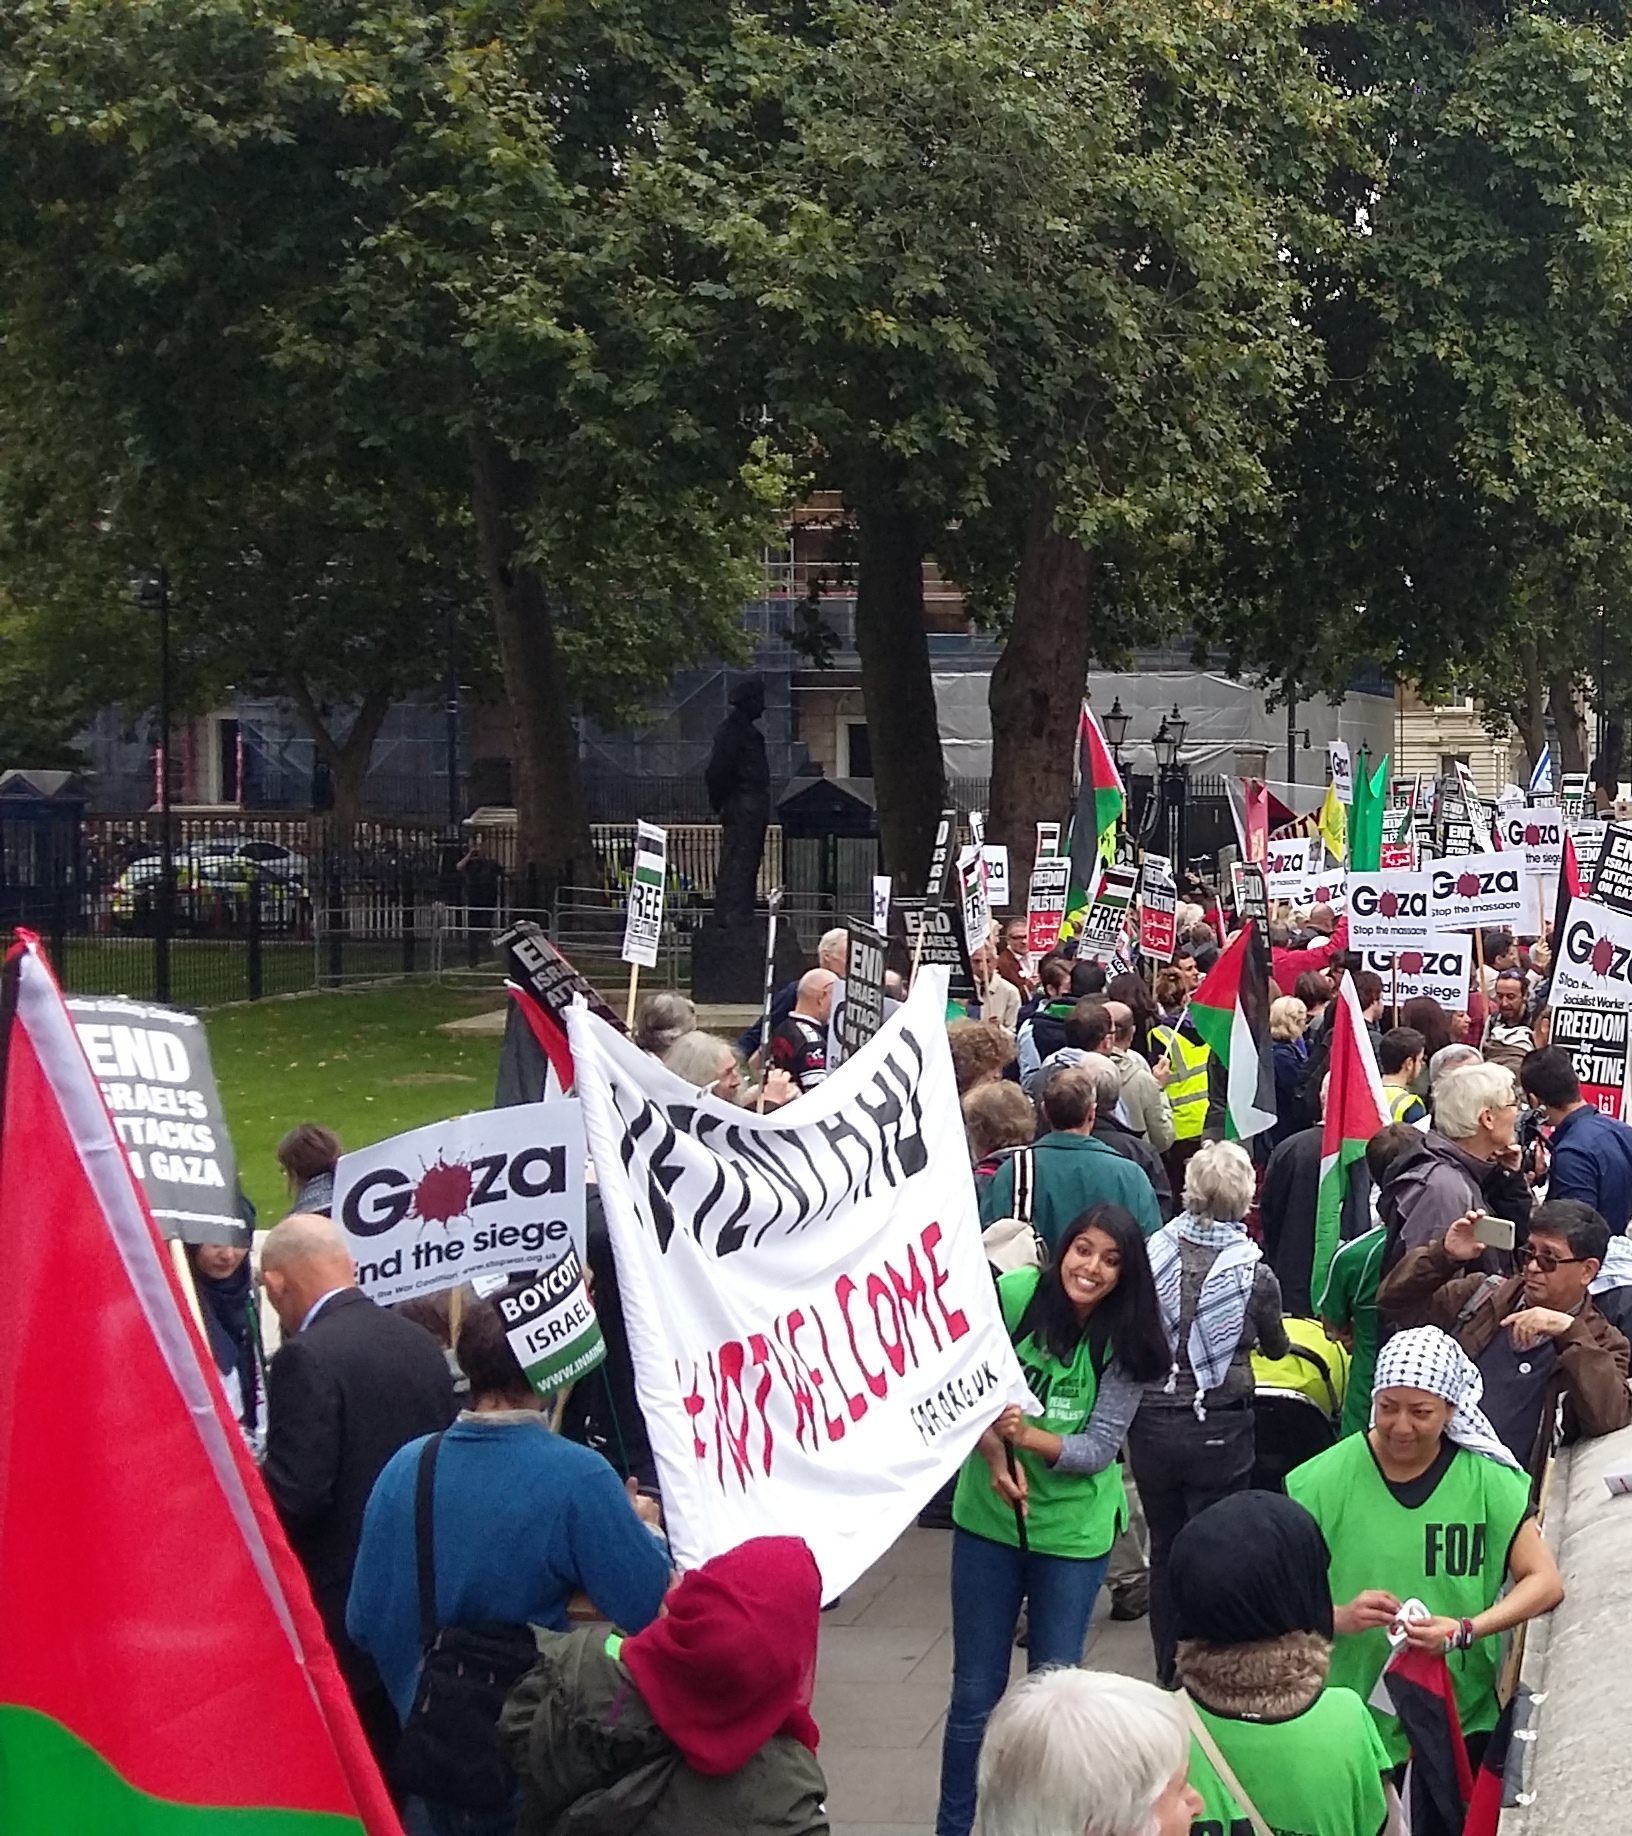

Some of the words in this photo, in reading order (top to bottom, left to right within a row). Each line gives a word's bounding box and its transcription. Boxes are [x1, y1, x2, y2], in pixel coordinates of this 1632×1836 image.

[1332, 751, 1350, 778] Gza
[1393, 795, 1424, 808] FRE
[1443, 800, 1465, 815] END
[1508, 819, 1560, 846] Gza
[1267, 851, 1303, 874] Gza
[1526, 852, 1541, 864] the
[1294, 882, 1348, 906] Gza
[1432, 870, 1519, 900] Gza
[1597, 882, 1614, 895] ON
[1352, 885, 1428, 920] Gza
[1454, 903, 1470, 914] the
[1471, 900, 1521, 913] massacre
[1085, 904, 1127, 932] FREE
[1353, 925, 1374, 937] Stop
[1376, 925, 1389, 935] the
[1390, 926, 1428, 936] massacre
[1367, 950, 1463, 977] Gza
[1396, 982, 1418, 995] the
[1422, 983, 1461, 1001] siege
[1563, 993, 1596, 1007] Socialist
[1596, 994, 1625, 1010] Worker
[1554, 1008, 1627, 1043] FREEDOM
[74, 1023, 191, 1083] END
[1580, 1039, 1593, 1053] for
[1572, 1052, 1625, 1086] ESTINE
[99, 1082, 209, 1119] SRAEL'S
[112, 1116, 217, 1153] TTACKS
[149, 1151, 225, 1188] GAZA
[342, 1145, 567, 1237] Gza
[354, 1250, 403, 1286] nd
[411, 1239, 465, 1271] the
[472, 1219, 568, 1252] siege
[395, 1284, 414, 1295] War
[500, 1251, 581, 1323] BOYCOTT
[525, 1298, 591, 1354] ISRAEL
[1424, 1522, 1486, 1577] FOA
